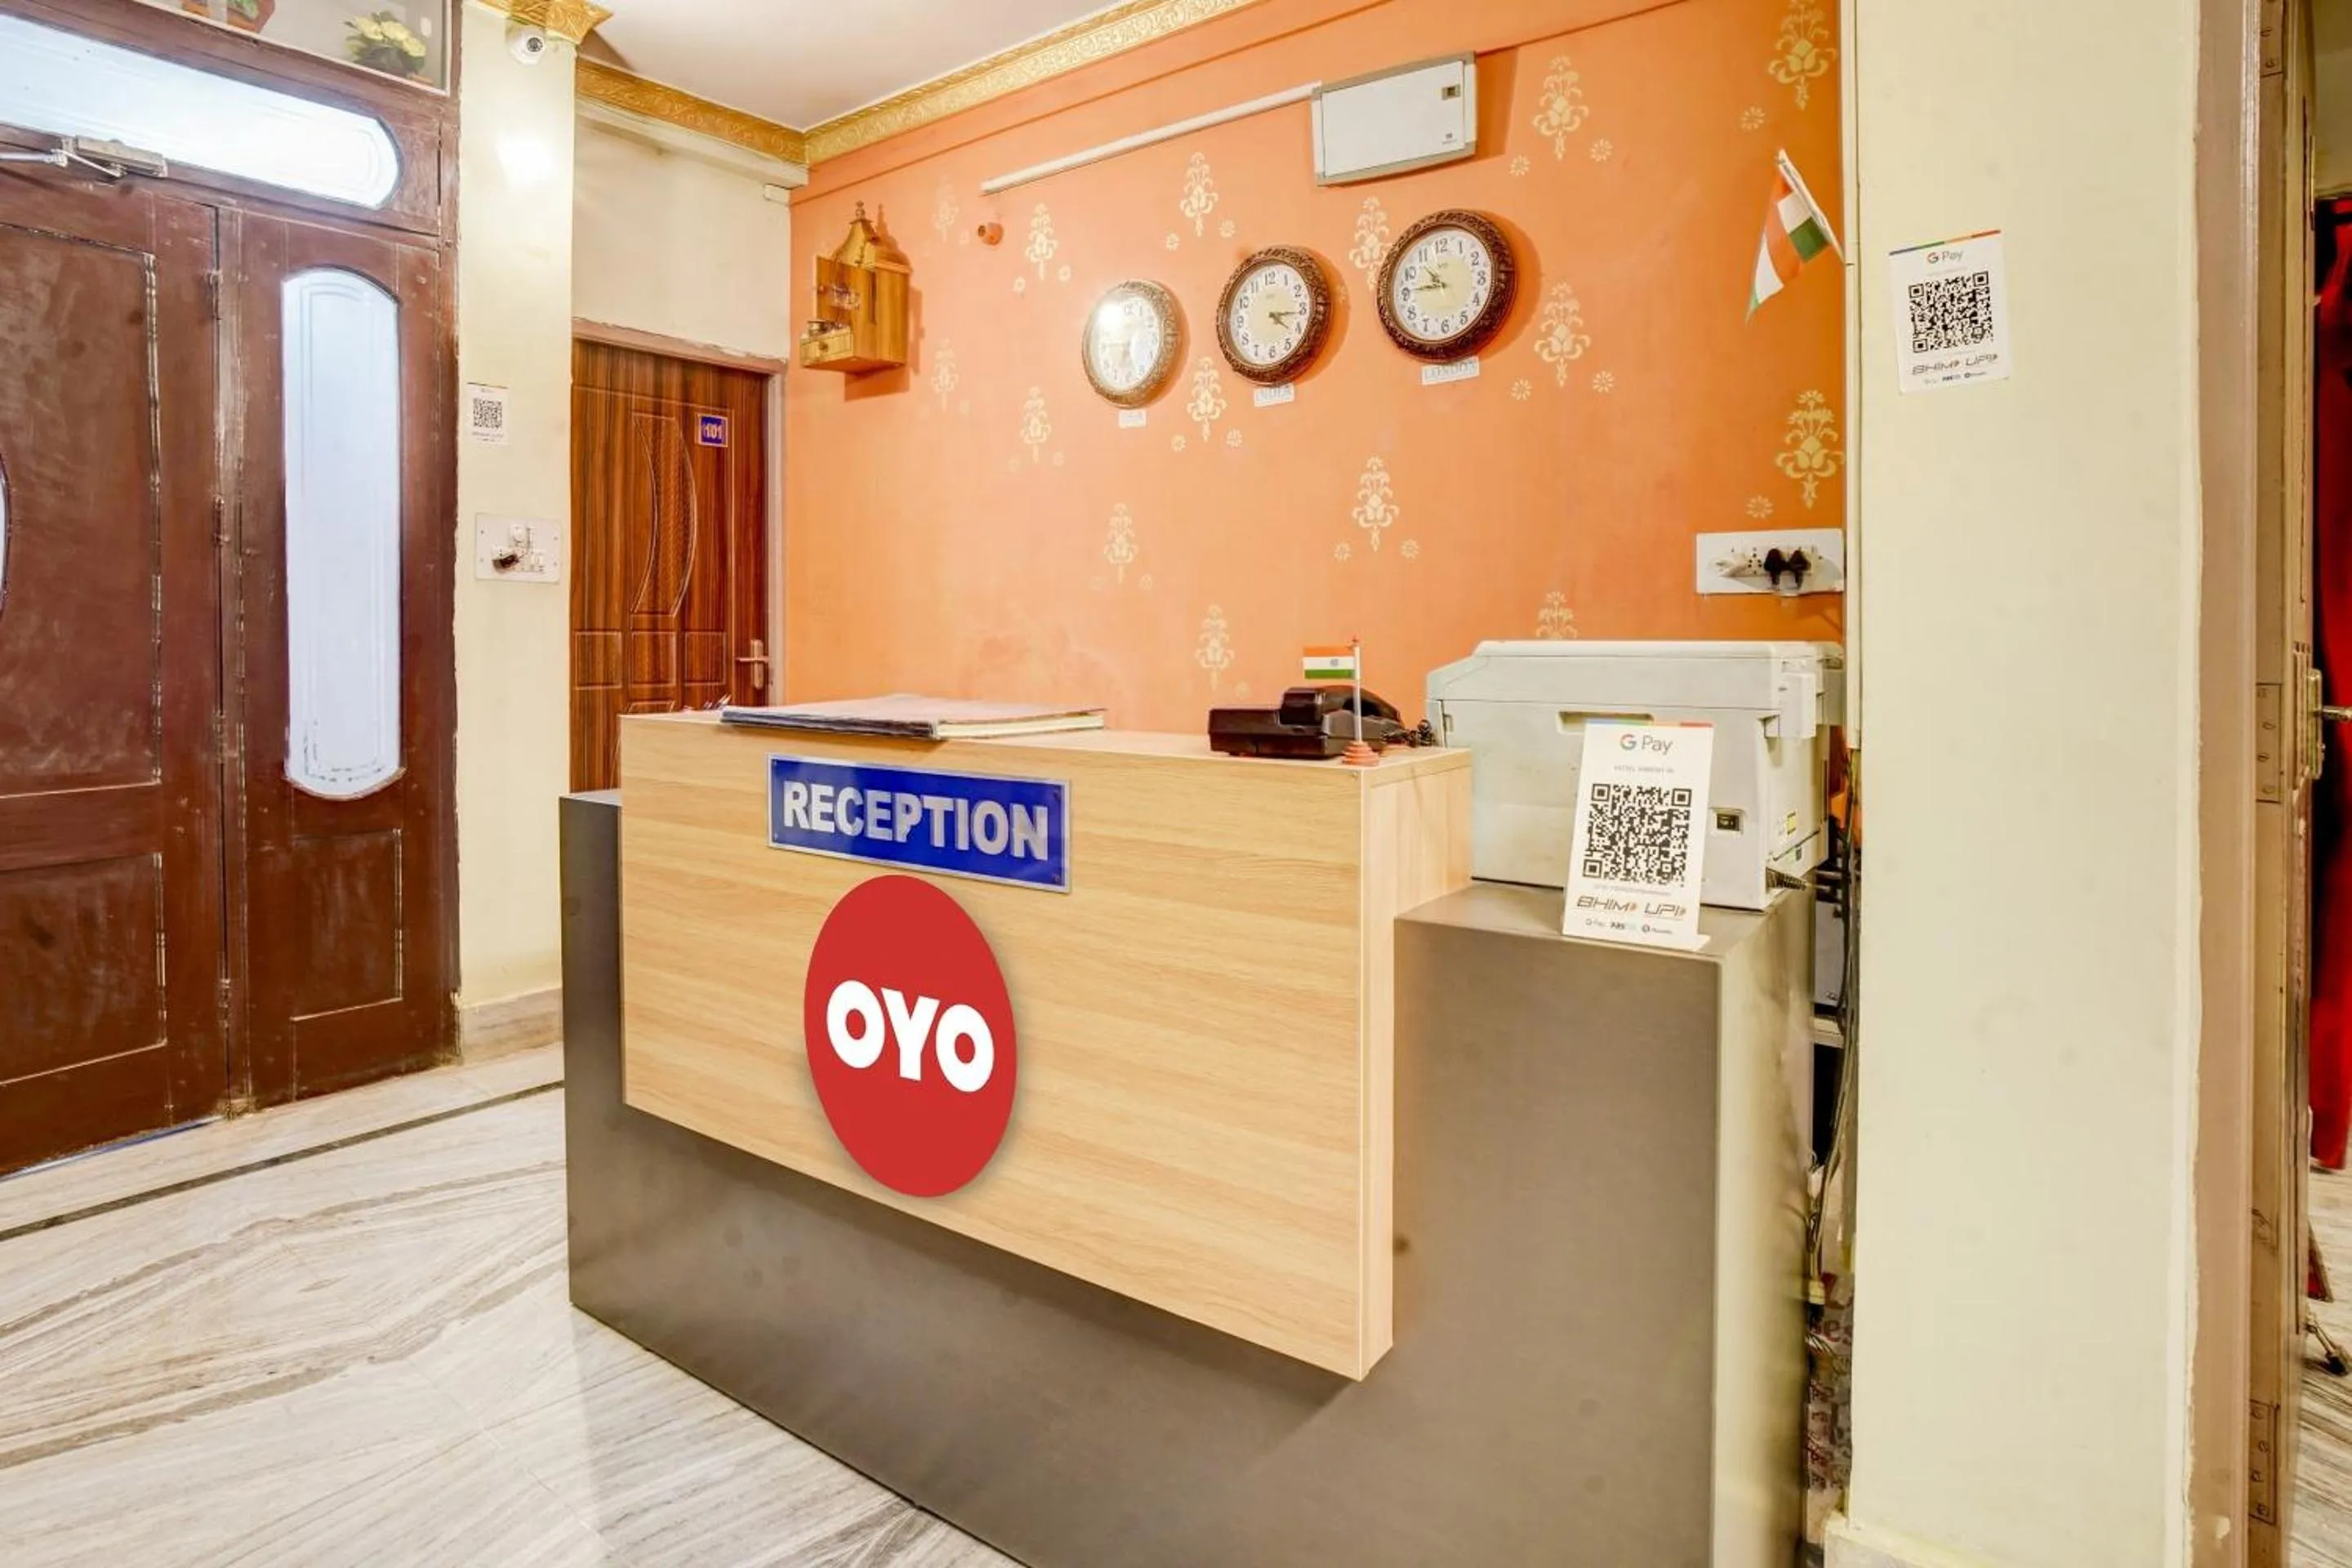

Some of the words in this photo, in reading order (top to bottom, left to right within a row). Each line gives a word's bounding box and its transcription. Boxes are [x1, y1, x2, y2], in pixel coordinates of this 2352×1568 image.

[1435, 238, 1448, 255] 12
[1458, 241, 1463, 254] 1
[1419, 247, 1428, 262] 11
[1471, 252, 1480, 265] 2
[1927, 252, 1939, 264] G
[1942, 251, 1963, 262] Pay
[1265, 271, 1276, 286] 12
[1283, 274, 1289, 286] 1
[1405, 266, 1416, 281] 10
[1477, 270, 1486, 285] 3
[1294, 284, 1302, 297] 2
[1401, 287, 1410, 301] 9
[1240, 296, 1249, 309] 10
[1472, 292, 1480, 306] 4
[1406, 306, 1416, 321] 8
[1459, 311, 1468, 325] 5
[1236, 315, 1244, 328] 9
[1423, 318, 1430, 332] 7
[1441, 319, 1450, 333] 6
[1241, 332, 1249, 345] 8
[1284, 338, 1291, 350] 5
[1254, 345, 1260, 357] 7
[1268, 346, 1276, 358] 6
[703, 423, 723, 439] 101
[1620, 733, 1637, 751] G
[1642, 734, 1673, 755] Pay
[782, 781, 1049, 861] RECEPTION
[1577, 895, 1630, 911] BHIM
[1644, 902, 1680, 916] UPI
[826, 980, 995, 1092] OYO
